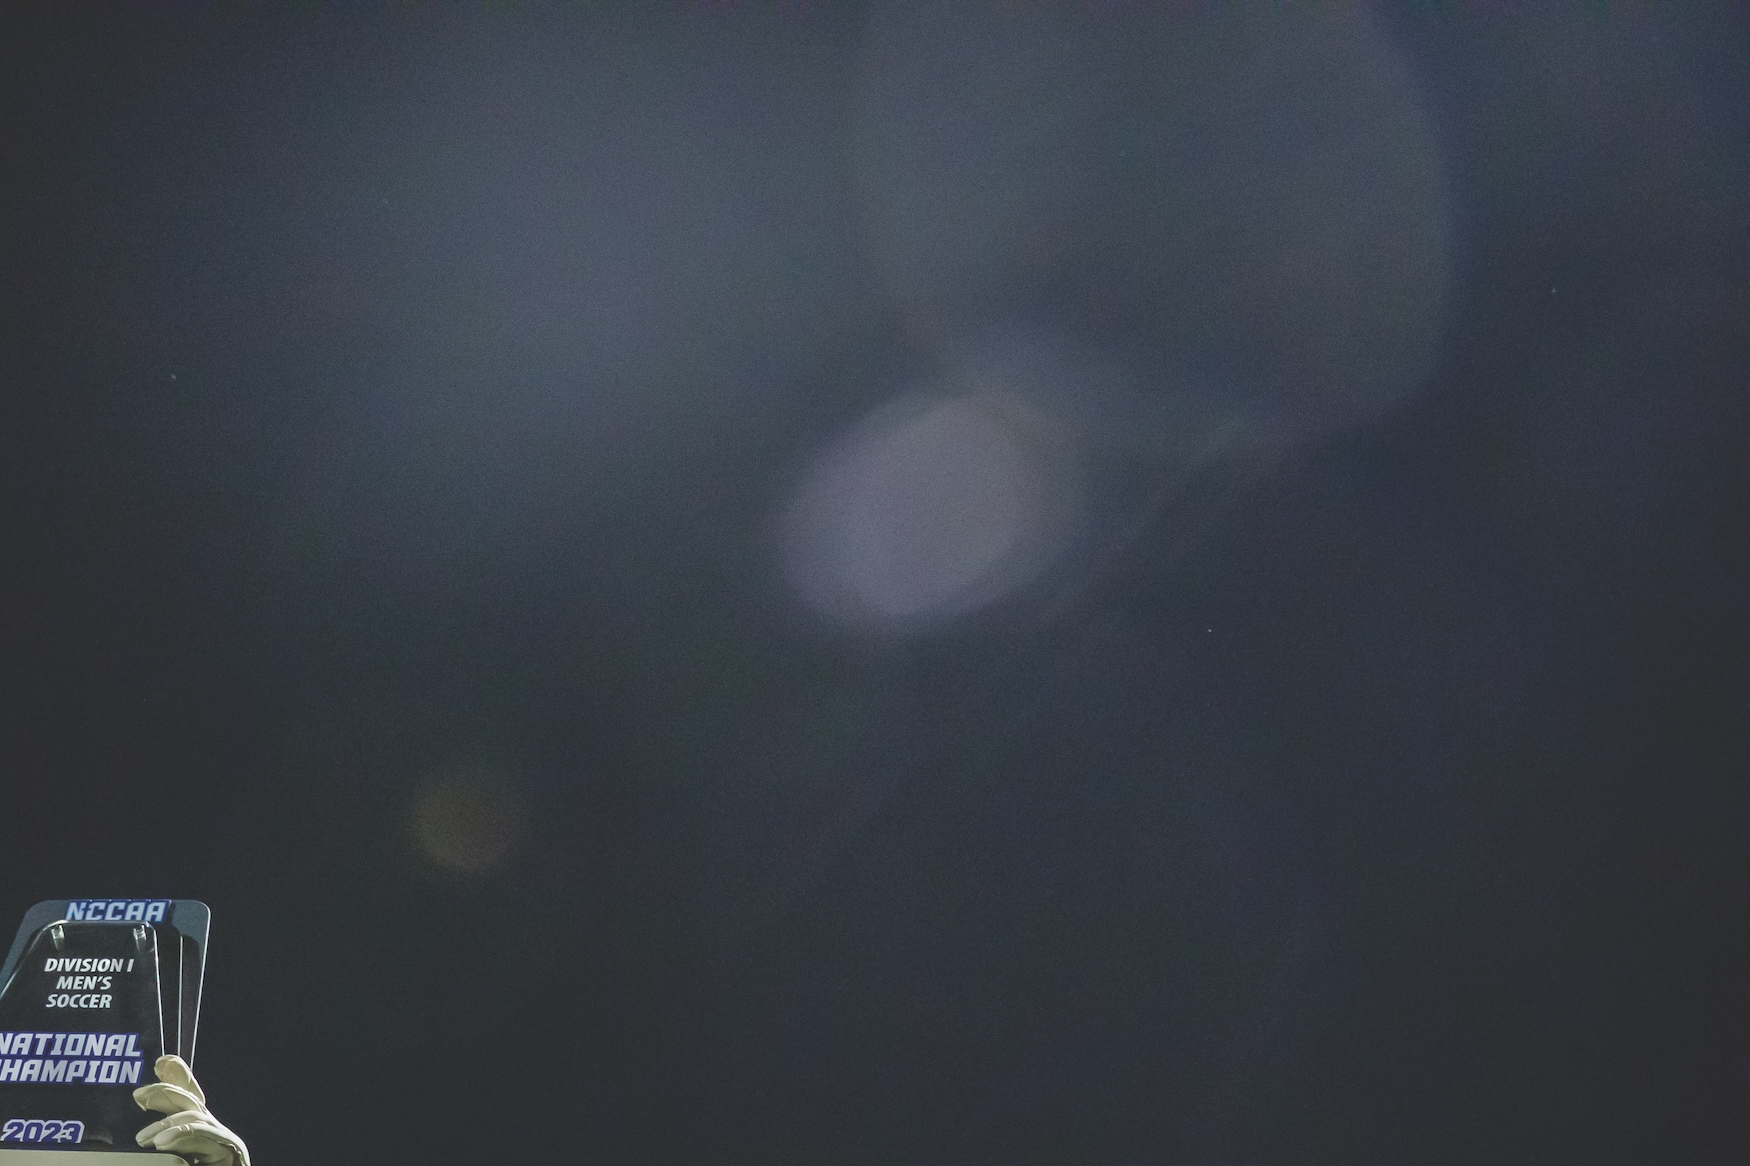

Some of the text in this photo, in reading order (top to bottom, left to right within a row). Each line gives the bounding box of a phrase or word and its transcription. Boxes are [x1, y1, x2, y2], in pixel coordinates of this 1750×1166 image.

[65, 901, 167, 922] NCCAA
[44, 958, 124, 973] DIVISION
[56, 976, 112, 990] MEN'S
[46, 994, 112, 1008] SOCCER
[0, 1119, 85, 1144] 2023
